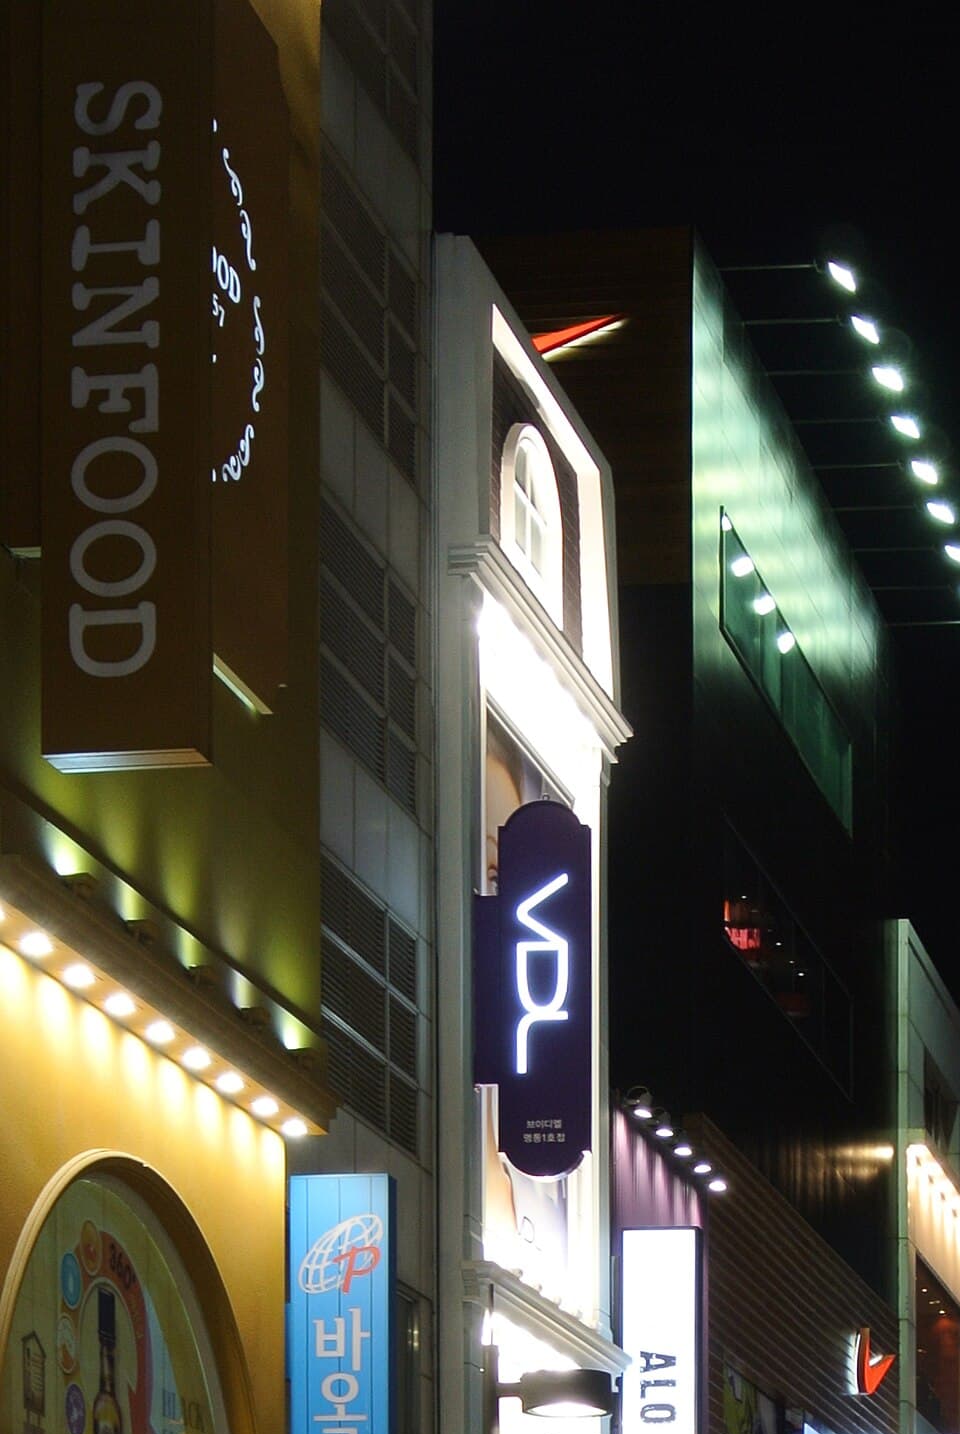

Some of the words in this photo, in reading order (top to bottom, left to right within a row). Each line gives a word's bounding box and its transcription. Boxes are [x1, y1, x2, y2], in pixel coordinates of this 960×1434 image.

[68, 79, 163, 679] SKINFOOD
[515, 872, 570, 1075] VDL
[639, 1350, 677, 1424] ALO
